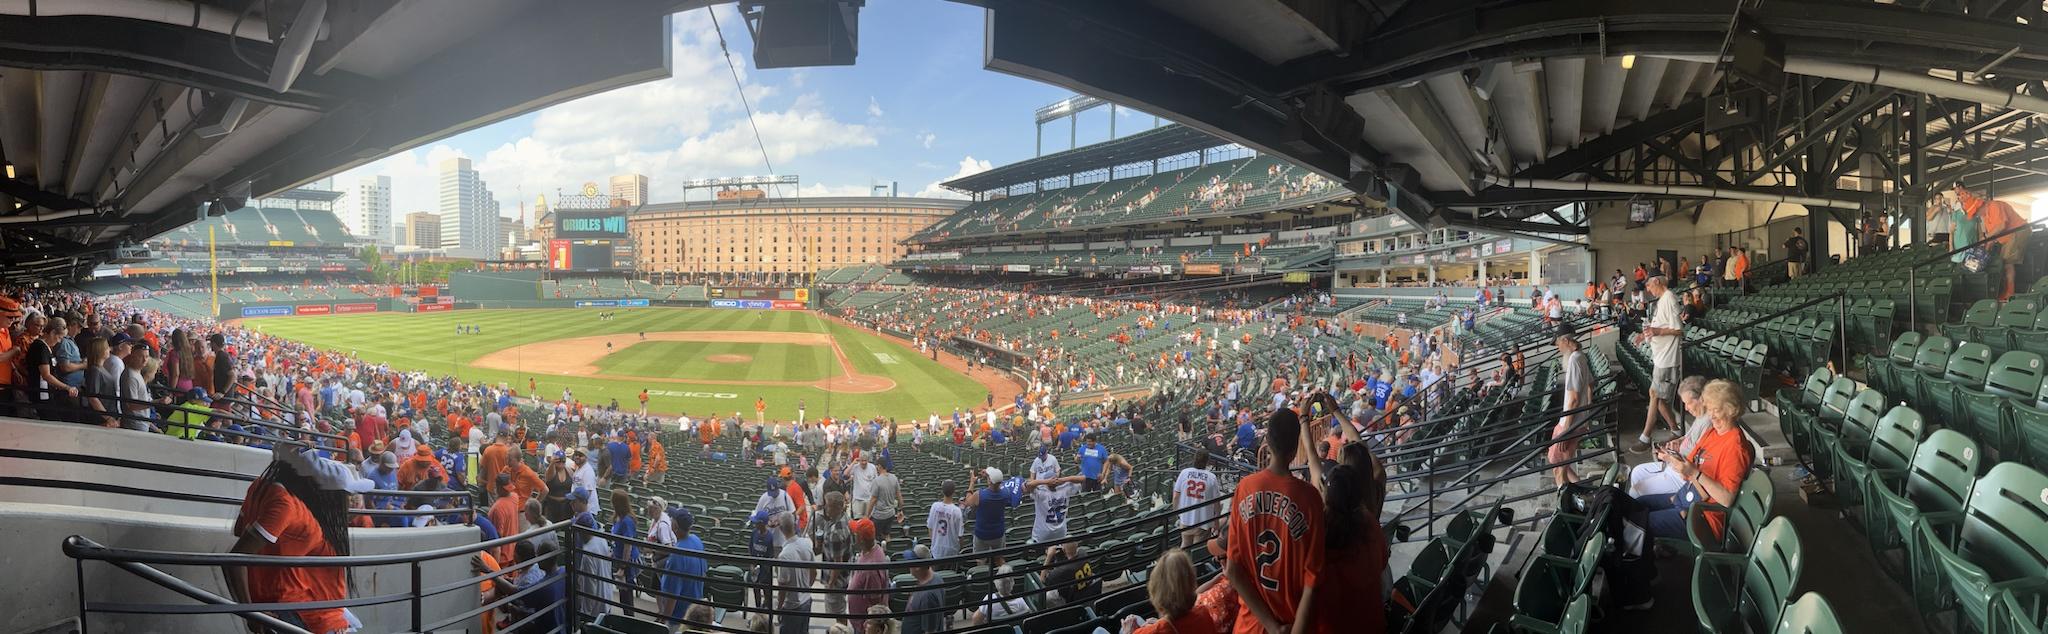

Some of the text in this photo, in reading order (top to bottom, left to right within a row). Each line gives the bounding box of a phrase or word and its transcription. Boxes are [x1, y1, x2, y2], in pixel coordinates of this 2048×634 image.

[562, 218, 601, 231] ORIOLES
[1186, 479, 1206, 499] 22
[1239, 491, 1310, 541] HENDERSON
[938, 519, 948, 537] 3
[1255, 529, 1282, 591] 2
